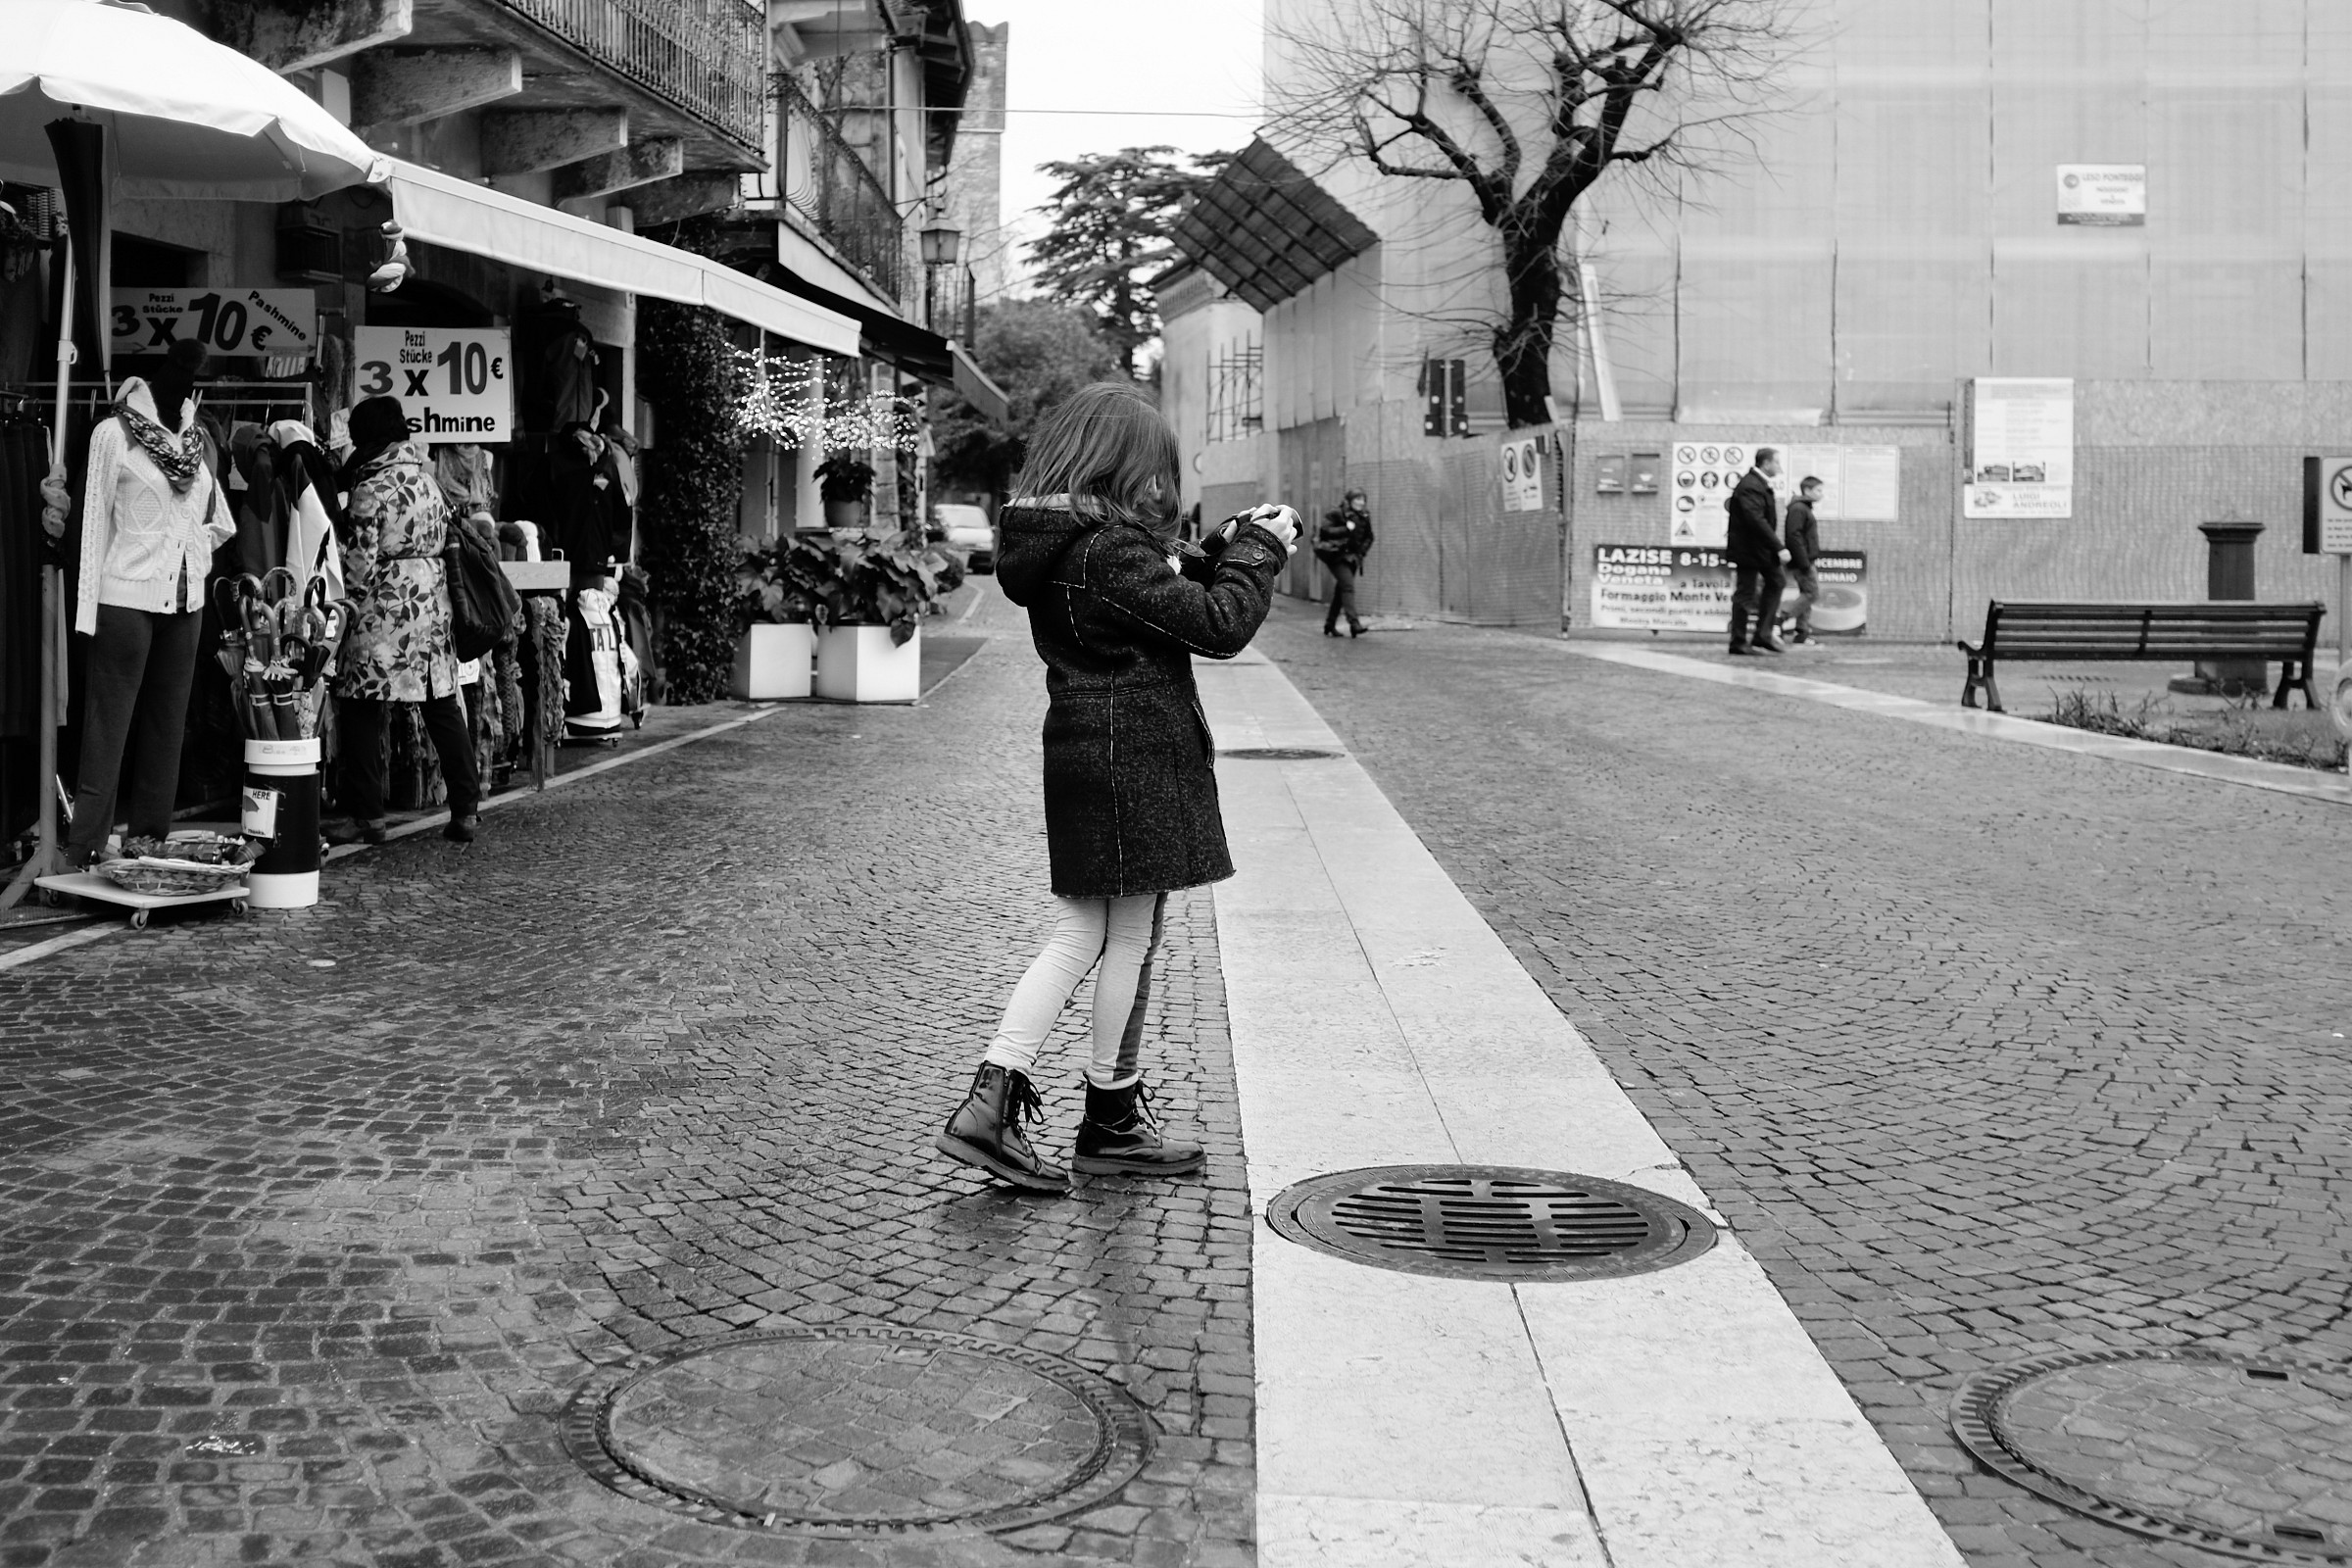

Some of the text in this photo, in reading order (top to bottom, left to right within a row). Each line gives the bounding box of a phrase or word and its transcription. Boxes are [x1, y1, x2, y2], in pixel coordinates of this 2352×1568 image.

[149, 293, 174, 303] Pezzi
[142, 305, 183, 314] Stücke
[247, 290, 308, 342] Pashmine
[111, 305, 140, 337] 3
[188, 292, 247, 352] 10
[250, 325, 273, 352] €
[405, 330, 425, 347] Pezzi
[399, 348, 433, 364] Stücke
[359, 360, 394, 396] 3
[436, 341, 488, 395] 10
[490, 357, 505, 379] €
[405, 407, 496, 434] shmine
[1597, 547, 1673, 565] LAZISE
[1679, 552, 1863, 569] 8-15- ICEMBRE
[1597, 563, 1672, 576] Dogana
[1818, 571, 1858, 583] ENNAIO
[1597, 573, 1664, 585] Veneta
[1600, 588, 1731, 603] Formaggio Monte Ve
[252, 789, 271, 801] HERE
